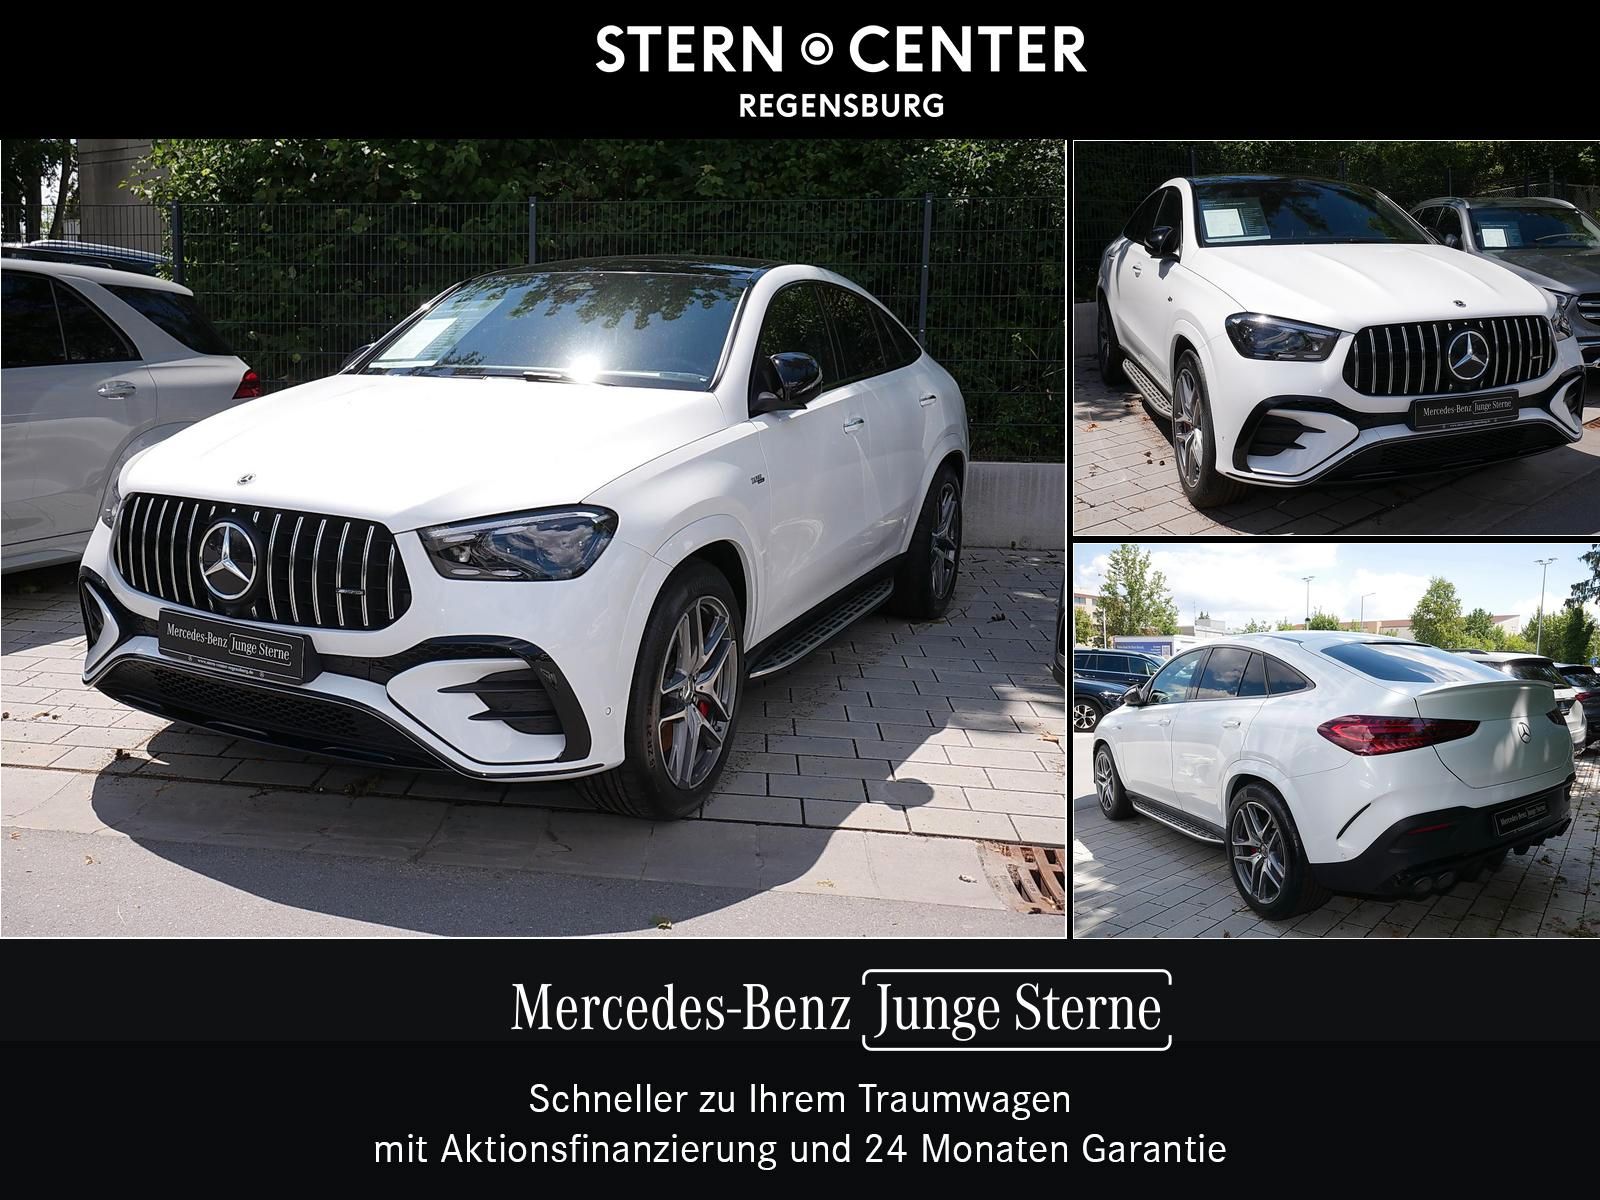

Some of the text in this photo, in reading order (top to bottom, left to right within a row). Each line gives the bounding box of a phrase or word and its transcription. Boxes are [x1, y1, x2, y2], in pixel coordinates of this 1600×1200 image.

[1423, 400, 1512, 417] Mercedes-Benz Junge Sterne
[167, 622, 290, 661] Mercedes-Benz Junge Sterne
